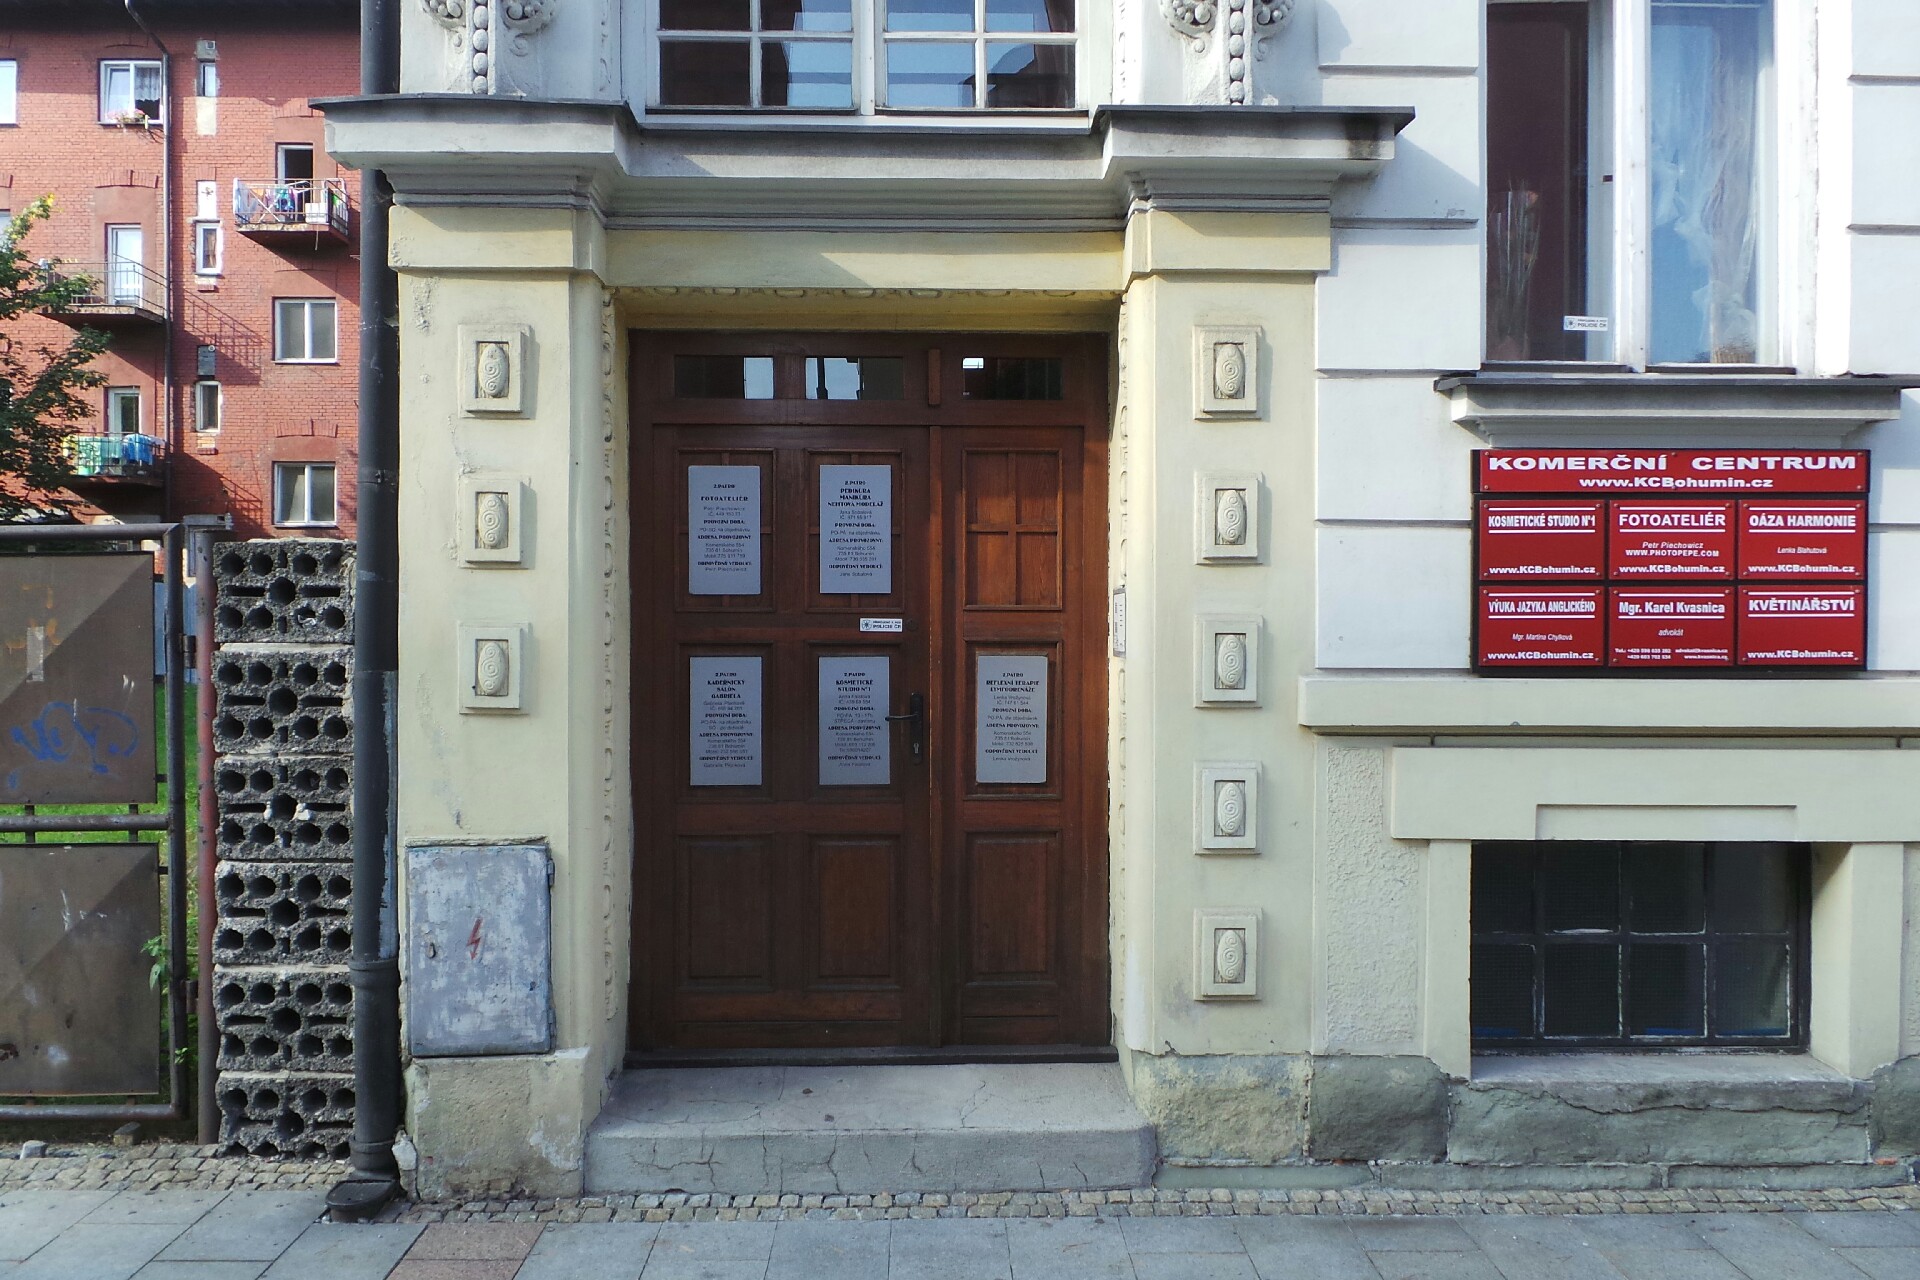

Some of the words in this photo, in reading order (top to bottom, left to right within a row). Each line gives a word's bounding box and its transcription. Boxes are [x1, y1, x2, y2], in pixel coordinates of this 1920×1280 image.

[1489, 454, 1667, 471] KOMERČNÍ
[1691, 456, 1856, 470] CENTRUM
[1579, 476, 1774, 488] www.KCBohumin.cz
[1488, 512, 1546, 527] KOSMETICKÉ
[1547, 514, 1580, 527] STUDIO
[1619, 511, 1726, 526] FOTOATELIÉR
[1749, 512, 1784, 527] OÁZA
[1787, 515, 1856, 527] HARMONIE
[1642, 541, 1659, 549] Petr
[1660, 541, 1704, 549] Piechowicz
[1625, 549, 1720, 557] WWW.PHOTOPEPE.COM
[1489, 565, 1596, 574] www.KCBohumin.cz
[1619, 564, 1726, 573] www.KCBohumin.cz
[1748, 564, 1855, 572] www.KCBohumin.cz
[1488, 598, 1516, 613] VÝUKA
[1516, 601, 1547, 613] JAZYKA
[1547, 598, 1596, 613] ANGLICKÉHO
[1619, 601, 1642, 615] Mgr.
[1644, 601, 1674, 613] Karel
[1676, 601, 1726, 613] Kvasnica
[1748, 597, 1855, 611] KVĚTINÁŘSTVÍ
[1526, 633, 1547, 641] Martina
[1658, 628, 1684, 637] advokát
[1487, 651, 1594, 660] www.KCBohumin.cz
[1747, 649, 1854, 658] www.KCBohumin.cz
